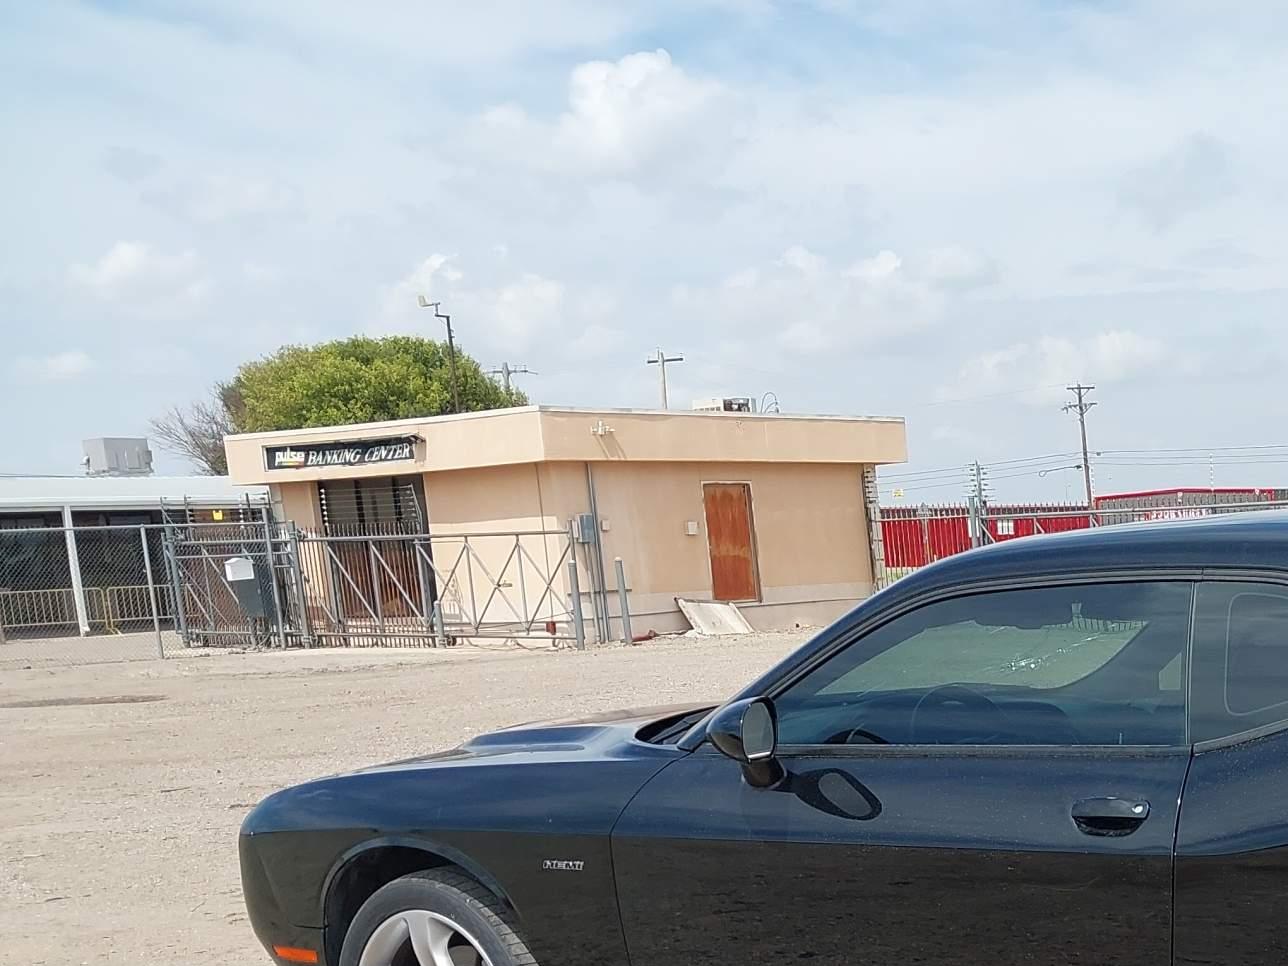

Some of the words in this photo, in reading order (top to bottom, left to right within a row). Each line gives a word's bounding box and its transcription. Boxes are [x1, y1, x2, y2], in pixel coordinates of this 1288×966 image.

[275, 447, 305, 466] pulse
[307, 449, 361, 466] BANKING
[364, 443, 410, 462] CENTER
